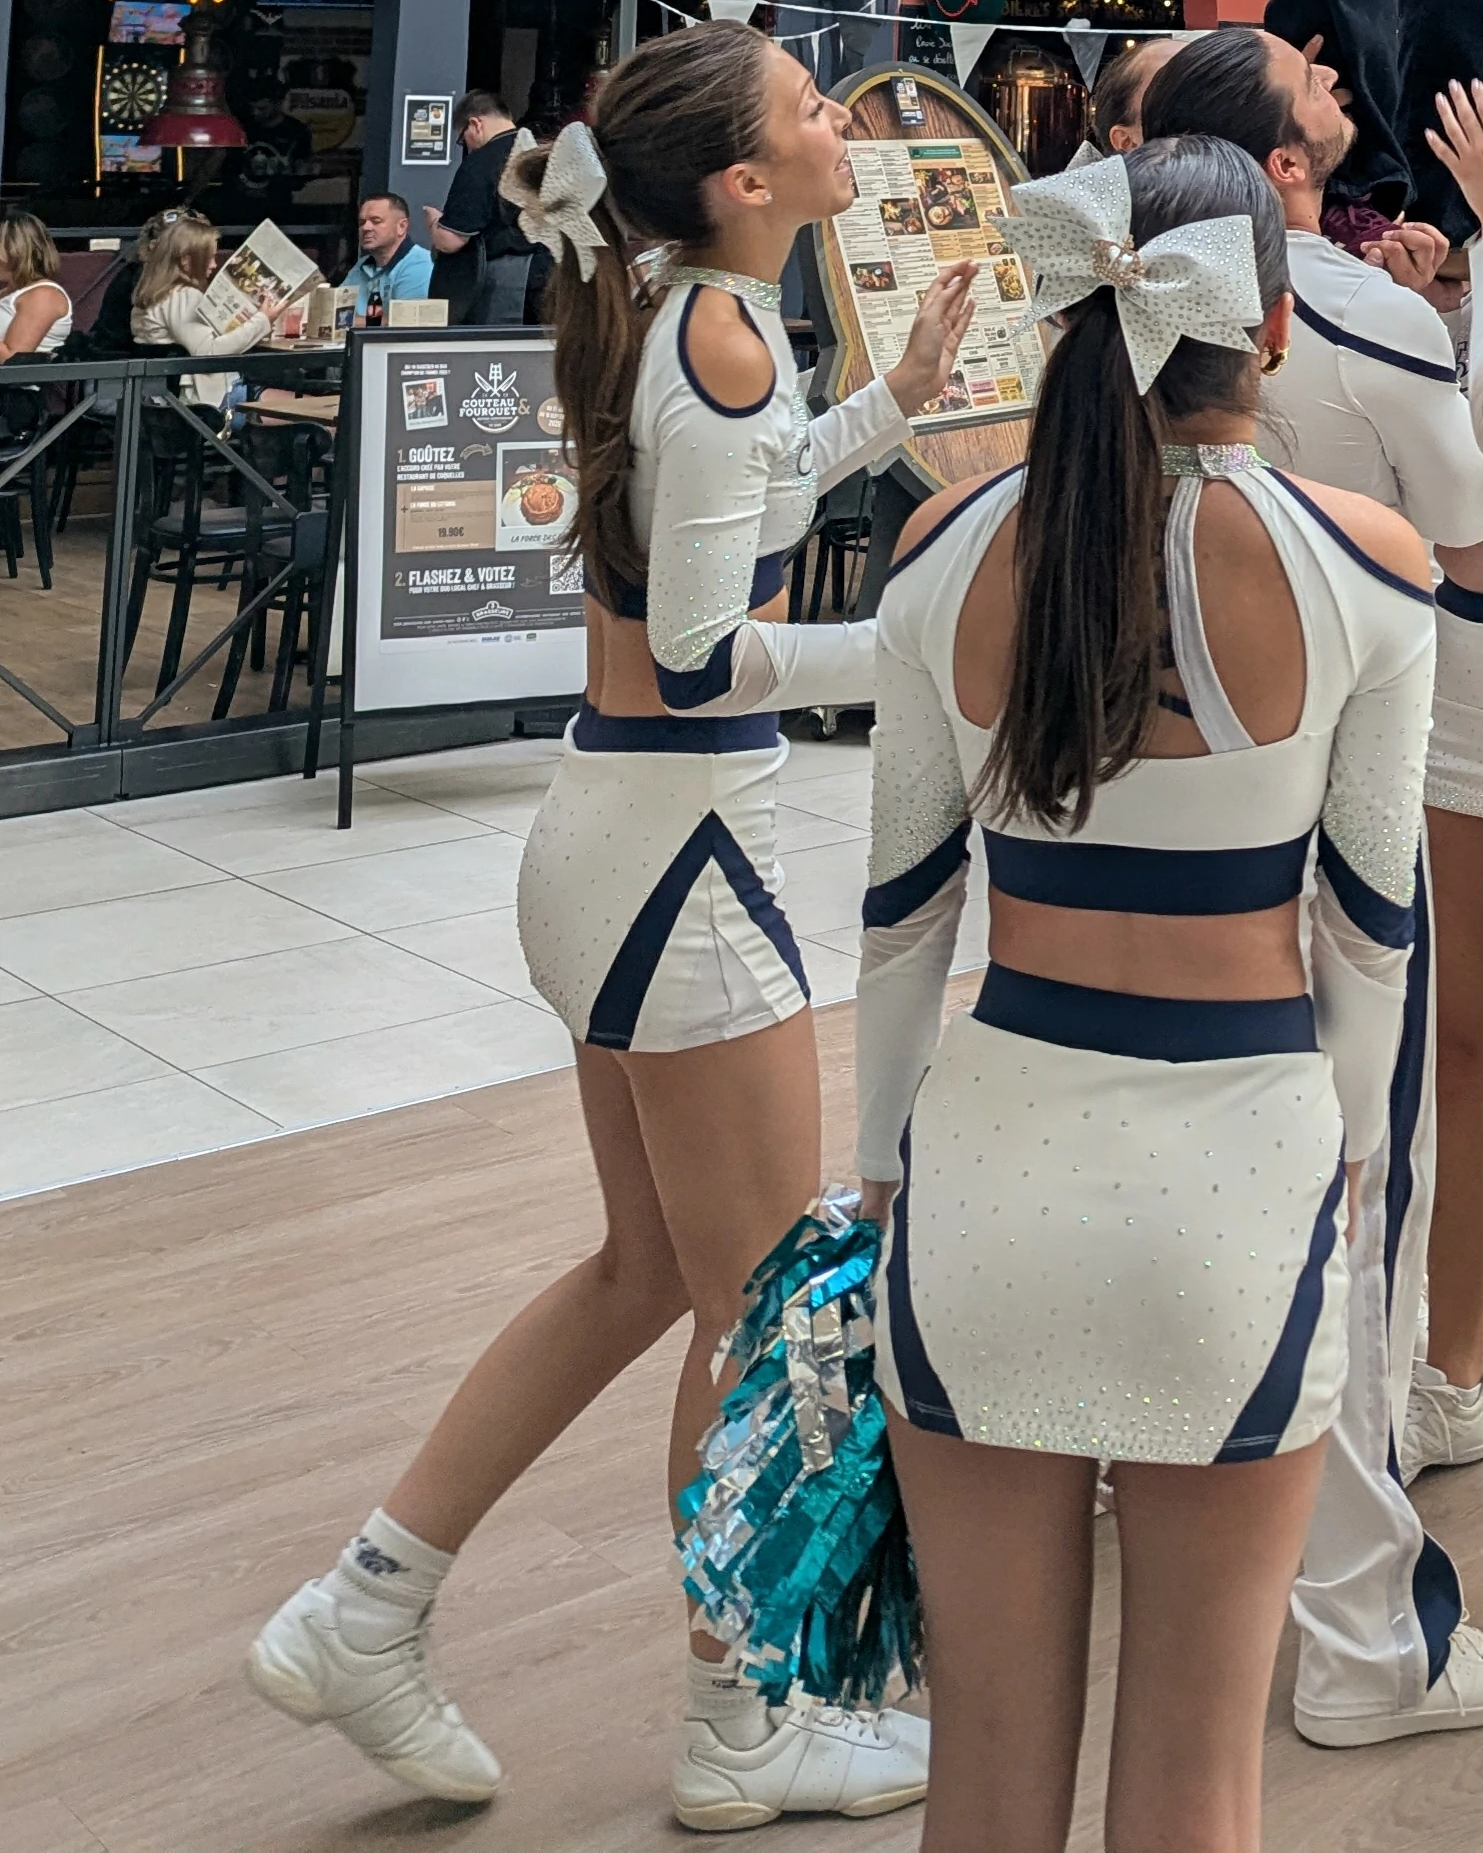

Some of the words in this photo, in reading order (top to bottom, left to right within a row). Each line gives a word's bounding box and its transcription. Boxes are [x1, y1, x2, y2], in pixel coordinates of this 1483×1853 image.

[462, 398, 515, 408] COUTEAU
[459, 406, 518, 418] FOURQUET
[409, 444, 455, 464] GOÛTEZ
[409, 568, 461, 586] FLASHEZ
[464, 568, 476, 583] &
[477, 565, 516, 582] VOTEZ
